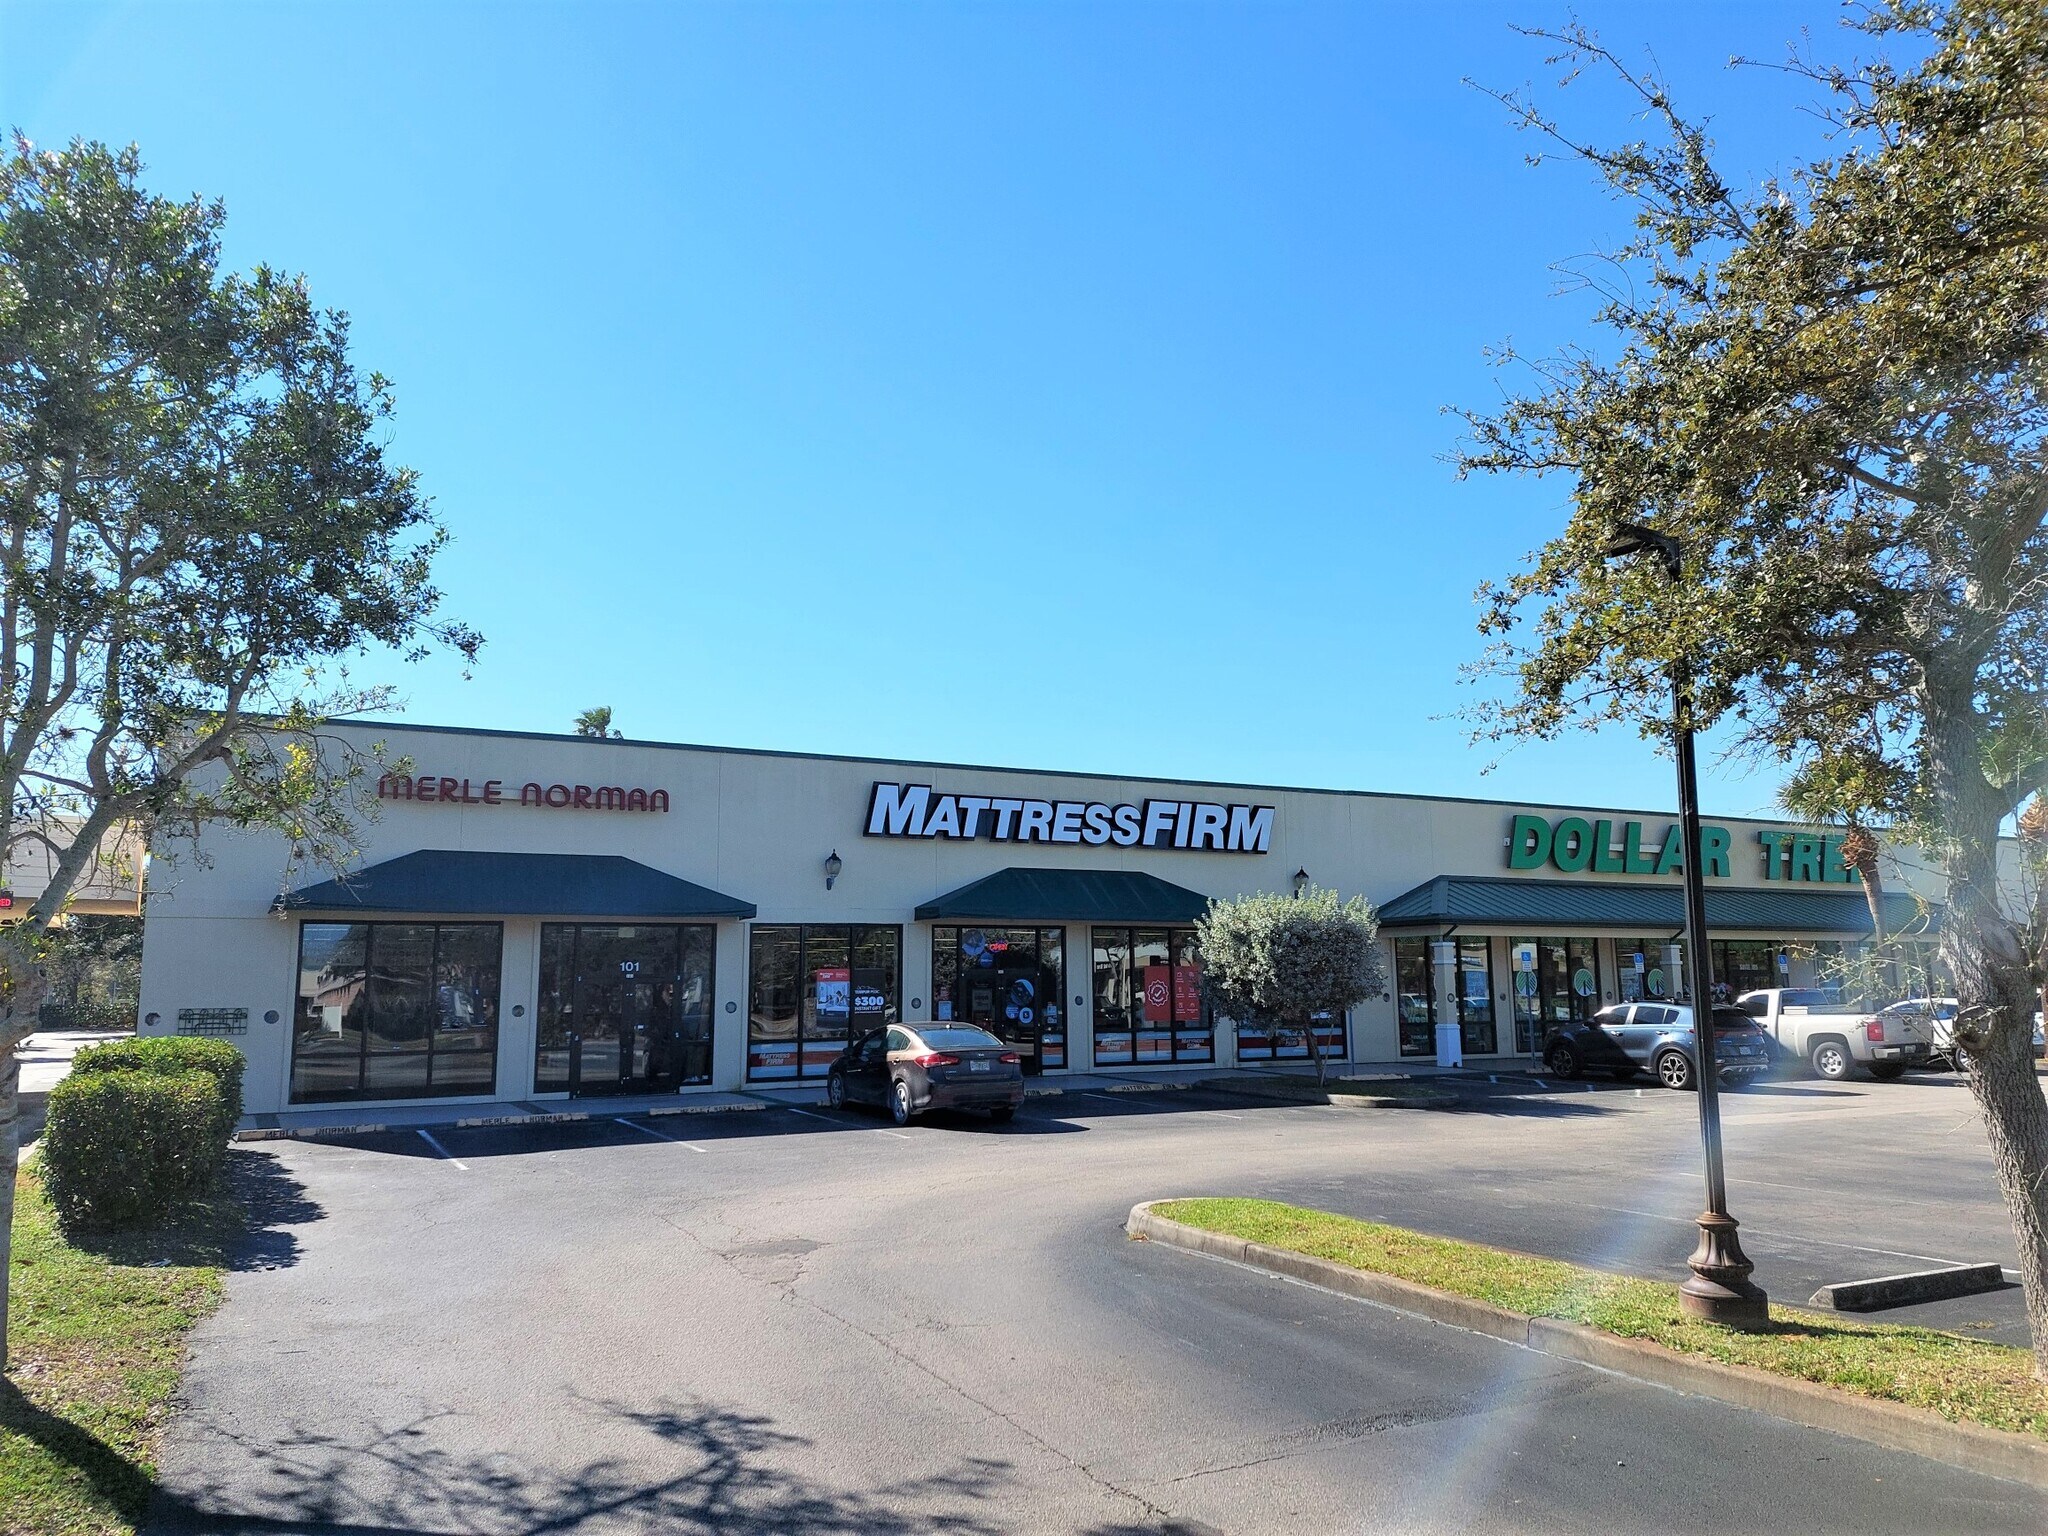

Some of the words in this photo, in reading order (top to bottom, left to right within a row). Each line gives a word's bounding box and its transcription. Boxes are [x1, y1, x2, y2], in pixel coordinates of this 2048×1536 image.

[378, 773, 502, 805] MERLE
[521, 782, 670, 812] NORMAN
[1758, 831, 1861, 883] TRE
[620, 961, 640, 972] 101
[854, 996, 884, 1006] $300
